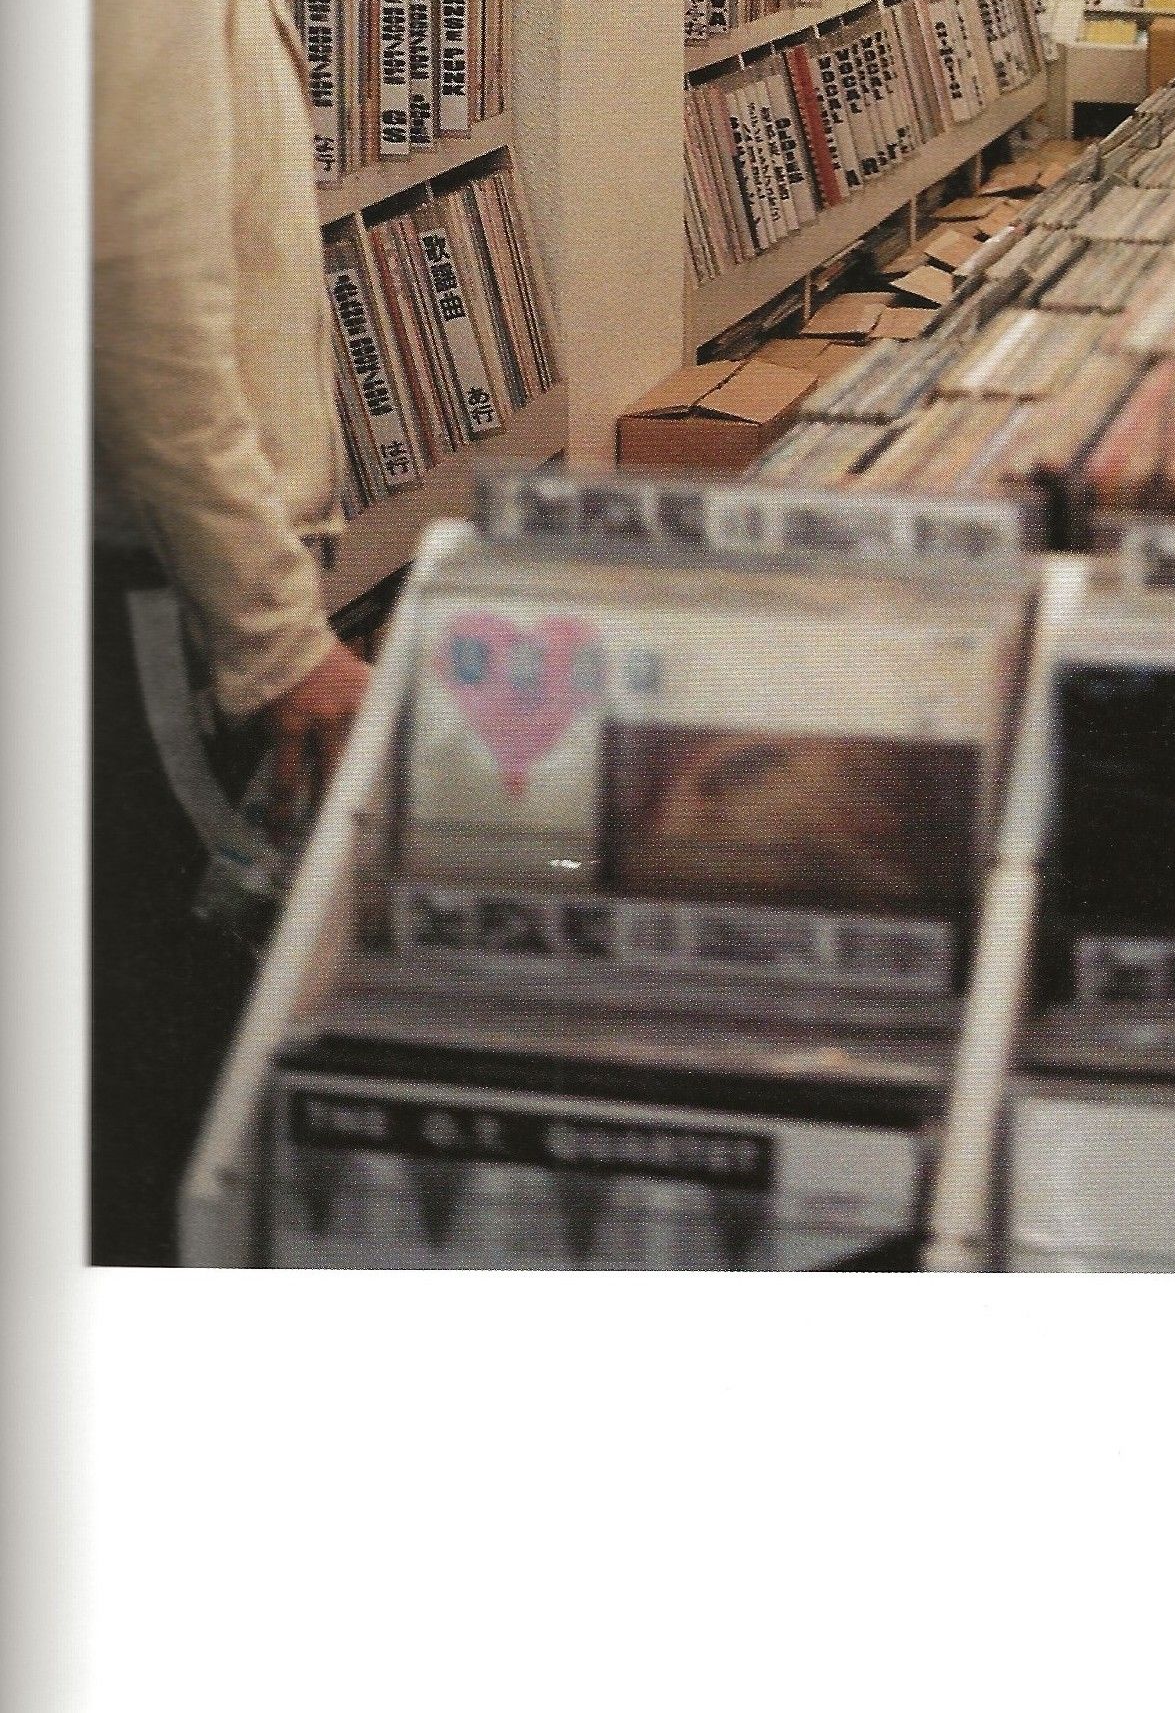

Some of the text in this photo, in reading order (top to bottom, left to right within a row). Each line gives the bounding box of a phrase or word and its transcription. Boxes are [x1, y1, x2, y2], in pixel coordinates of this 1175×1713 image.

[442, 48, 466, 97] PUNK
[422, 235, 495, 425] 歌謡曲 あ行
